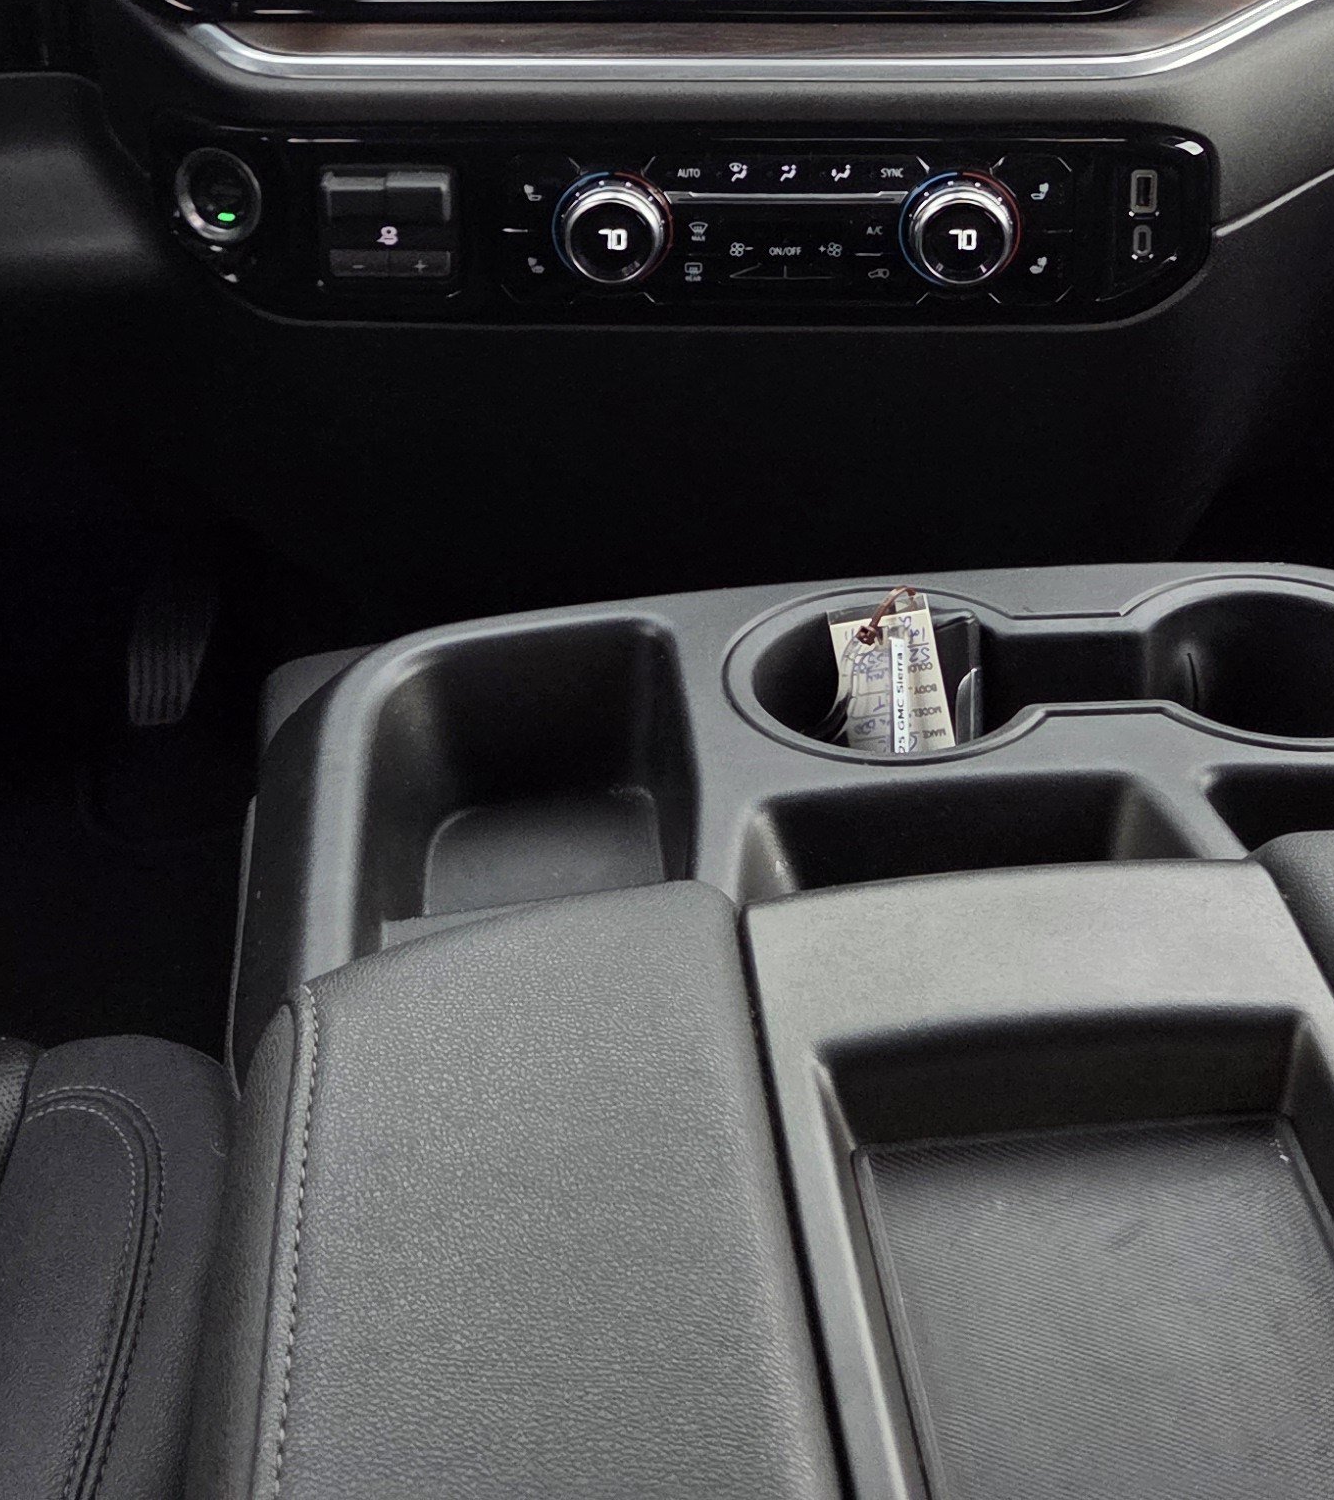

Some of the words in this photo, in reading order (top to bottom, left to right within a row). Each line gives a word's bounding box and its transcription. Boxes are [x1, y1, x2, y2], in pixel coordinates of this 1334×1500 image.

[677, 168, 701, 179] AUTO
[880, 167, 904, 179] SYNC
[866, 225, 884, 236] A/C
[597, 227, 628, 251] 70
[948, 228, 977, 251] 70
[768, 246, 802, 257] ON/OFF
[896, 652, 904, 694] Sierra
[913, 683, 938, 695] BODY
[897, 699, 905, 731] GMC
[912, 706, 942, 718] MODEL
[922, 728, 947, 739] MAKE
